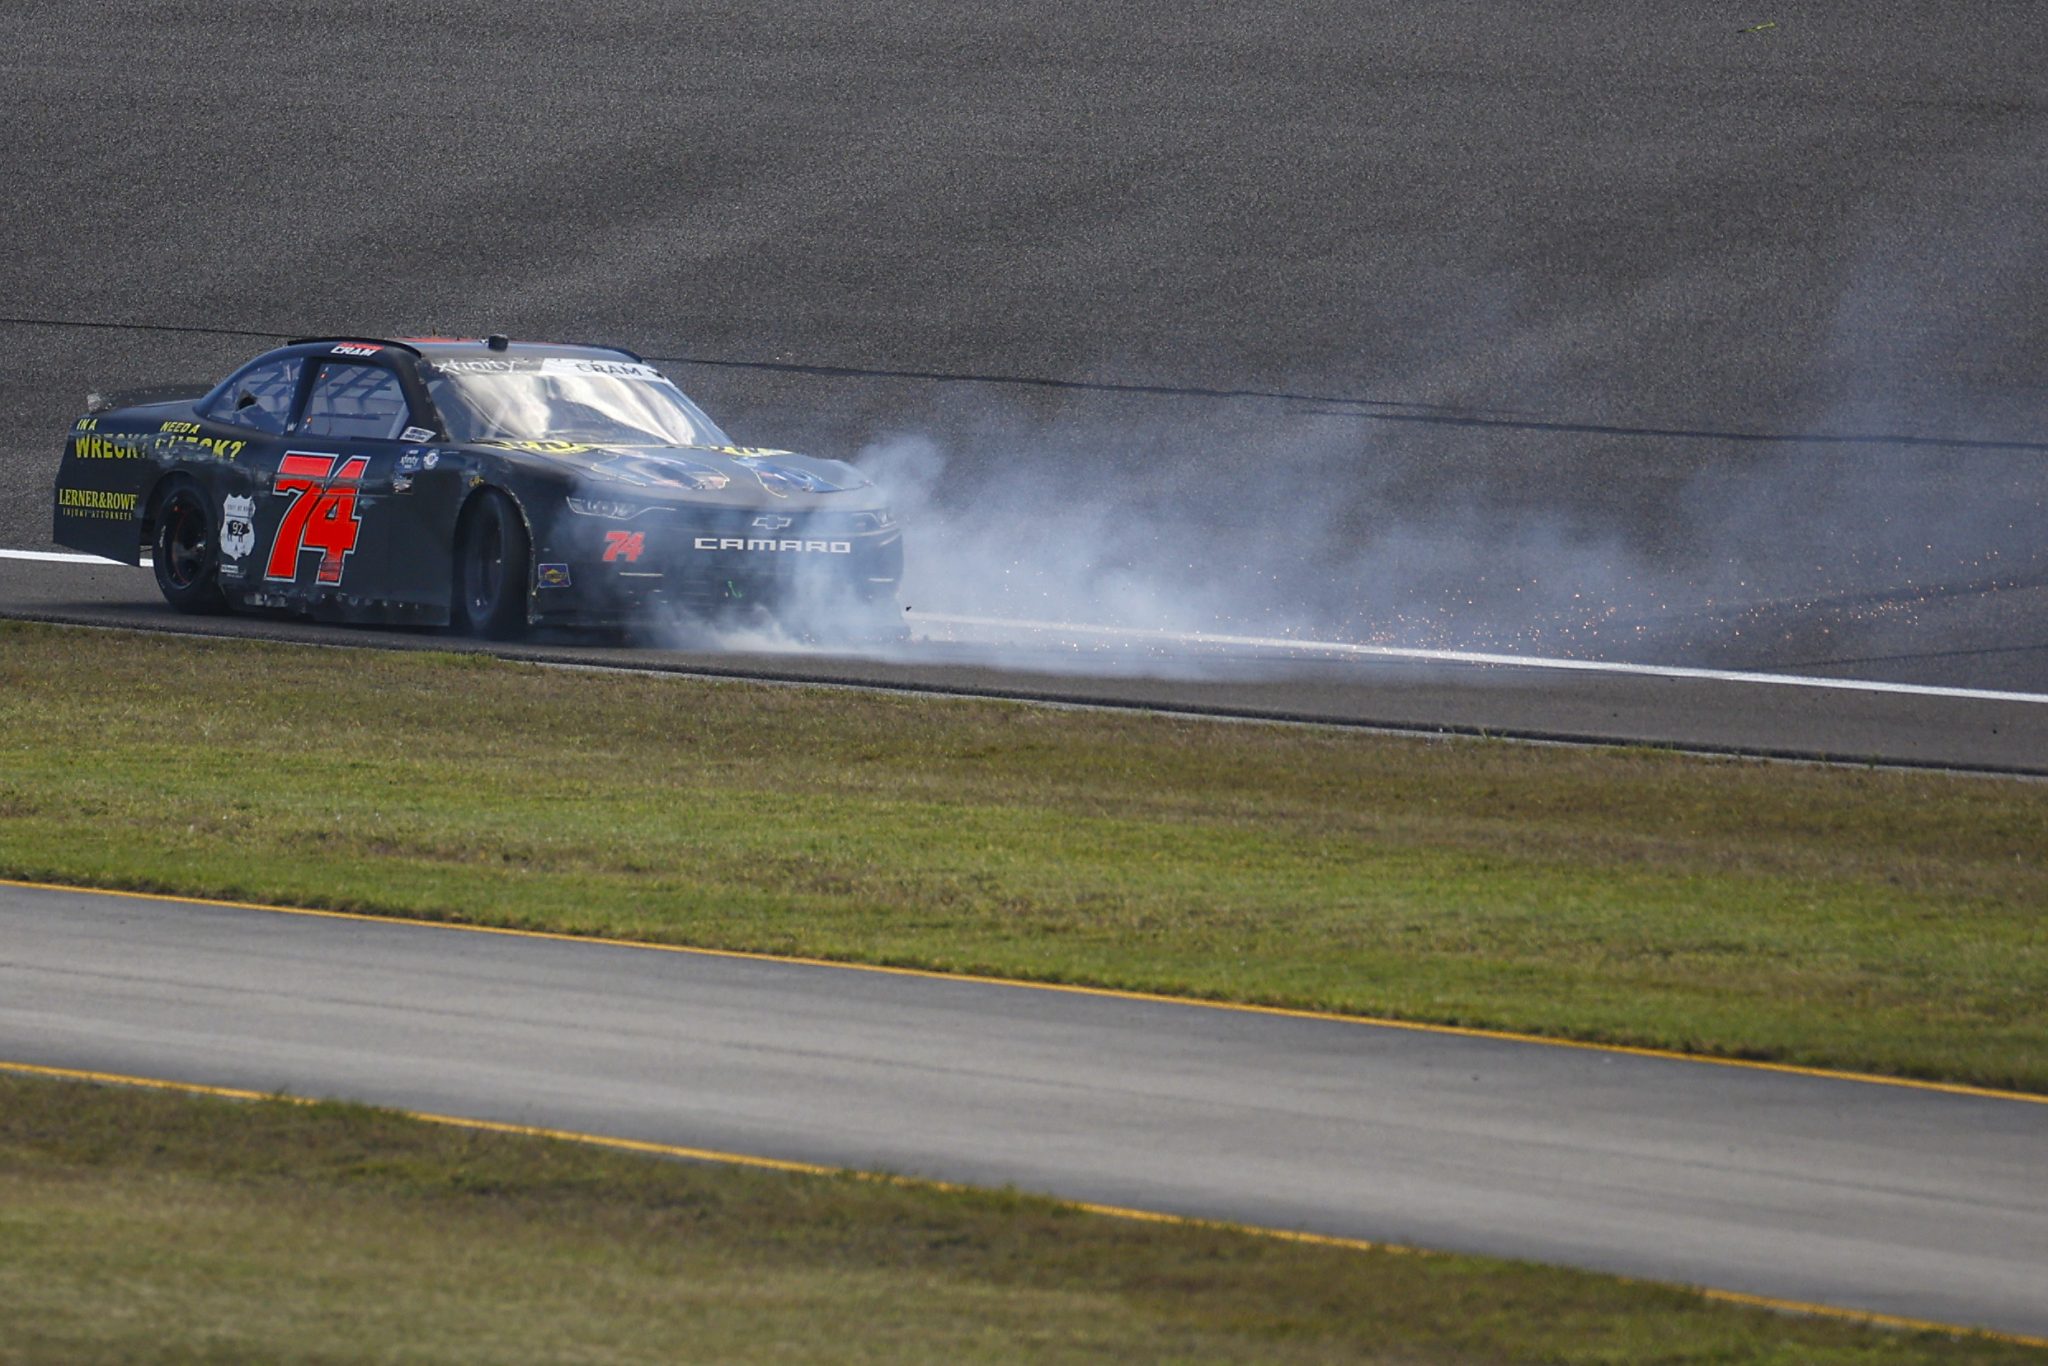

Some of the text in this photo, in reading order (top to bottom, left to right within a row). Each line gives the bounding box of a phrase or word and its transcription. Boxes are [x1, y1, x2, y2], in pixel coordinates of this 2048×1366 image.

[331, 346, 376, 356] CRAM
[576, 363, 642, 376] CRAM
[88, 418, 98, 430] A
[160, 421, 200, 434] NEED A
[264, 450, 371, 586] 74
[232, 521, 244, 535] 92
[602, 531, 645, 562] 74
[694, 538, 851, 553] CAMARO
